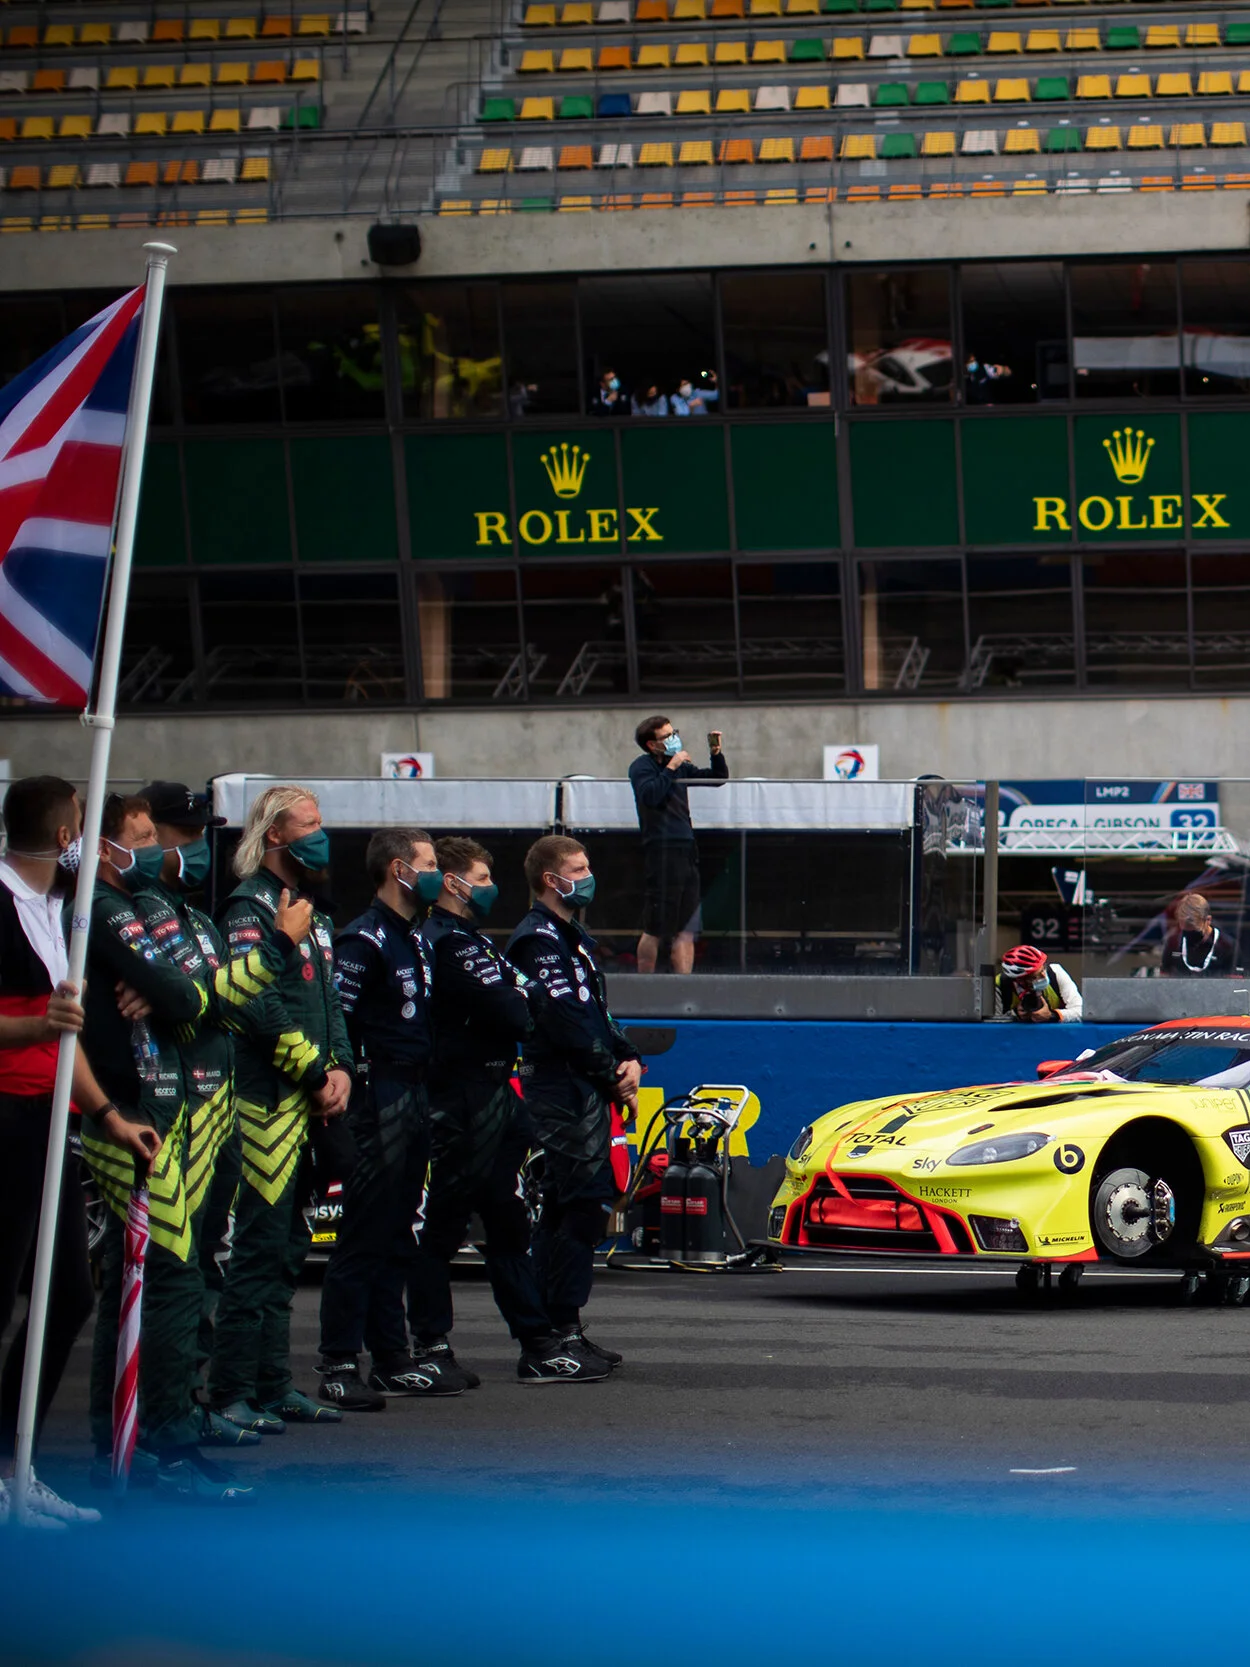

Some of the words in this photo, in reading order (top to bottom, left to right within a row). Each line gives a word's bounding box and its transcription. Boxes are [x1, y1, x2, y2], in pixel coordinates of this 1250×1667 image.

[1033, 494, 1230, 531] ROLEX
[474, 507, 664, 545] ROLEX
[1095, 786, 1130, 797] LMP2
[1030, 917, 1060, 939] 32
[844, 1132, 907, 1147] TOTAL
[1232, 1133, 1250, 1143] TAG
[912, 1156, 943, 1173] sky
[919, 1185, 973, 1198] HACKETT
[1051, 1235, 1086, 1244] MICHELIN
